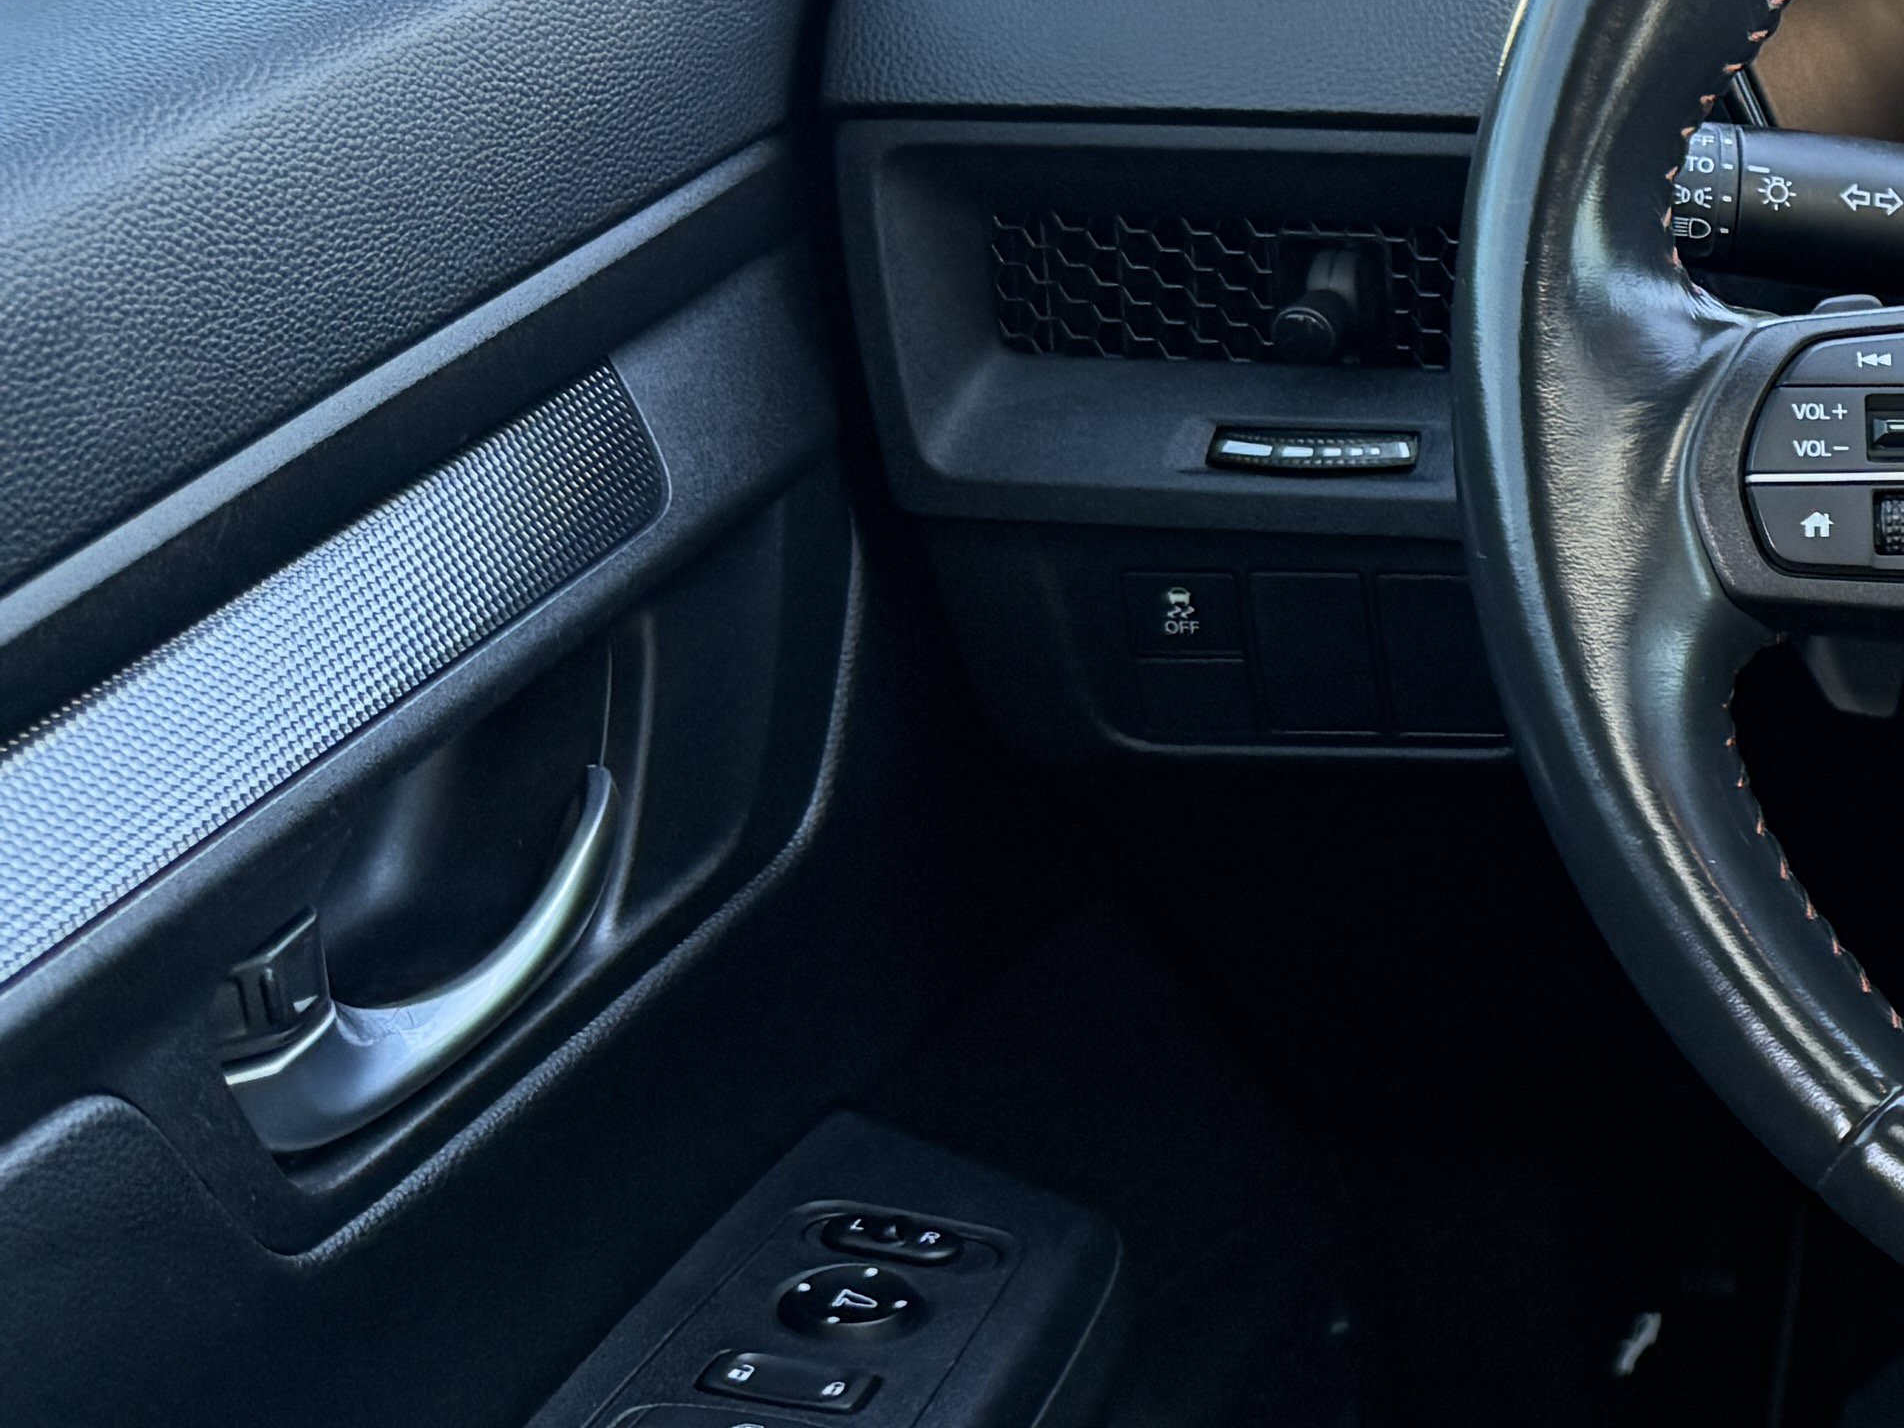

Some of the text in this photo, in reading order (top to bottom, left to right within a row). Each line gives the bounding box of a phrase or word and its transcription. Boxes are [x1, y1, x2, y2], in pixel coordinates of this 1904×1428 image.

[1164, 620, 1200, 634] OFF
[849, 1218, 865, 1230] L
[918, 1231, 941, 1245] R
